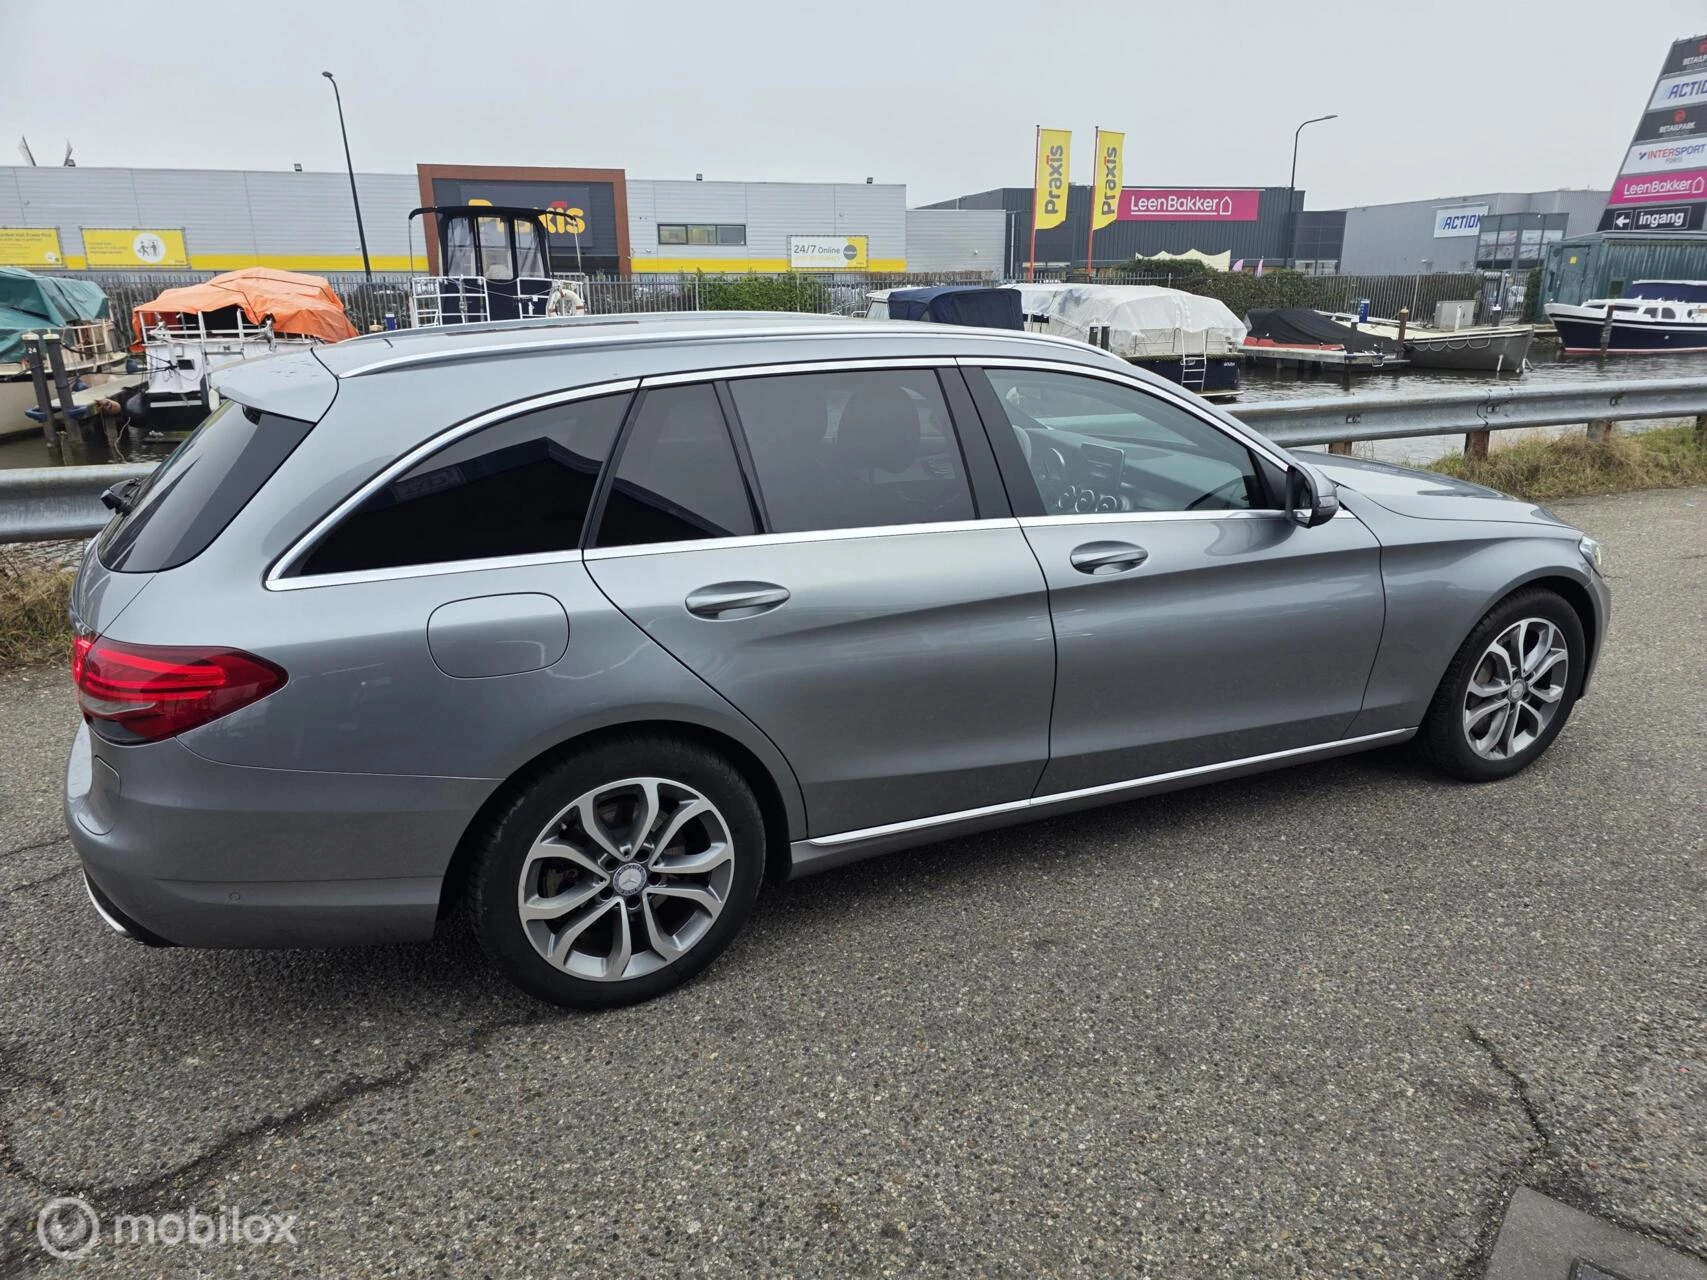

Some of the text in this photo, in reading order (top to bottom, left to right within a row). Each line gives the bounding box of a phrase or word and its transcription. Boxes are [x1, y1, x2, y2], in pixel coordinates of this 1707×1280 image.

[1647, 144, 1706, 160] INTERSPORT
[1044, 145, 1064, 214] Praxis
[1101, 147, 1118, 215] Praxis
[1624, 179, 1692, 195] LeenBakker
[1130, 195, 1218, 211] LeenBakker
[1638, 212, 1684, 228] ingang
[793, 244, 816, 254] 24/7
[818, 246, 840, 254] Online
